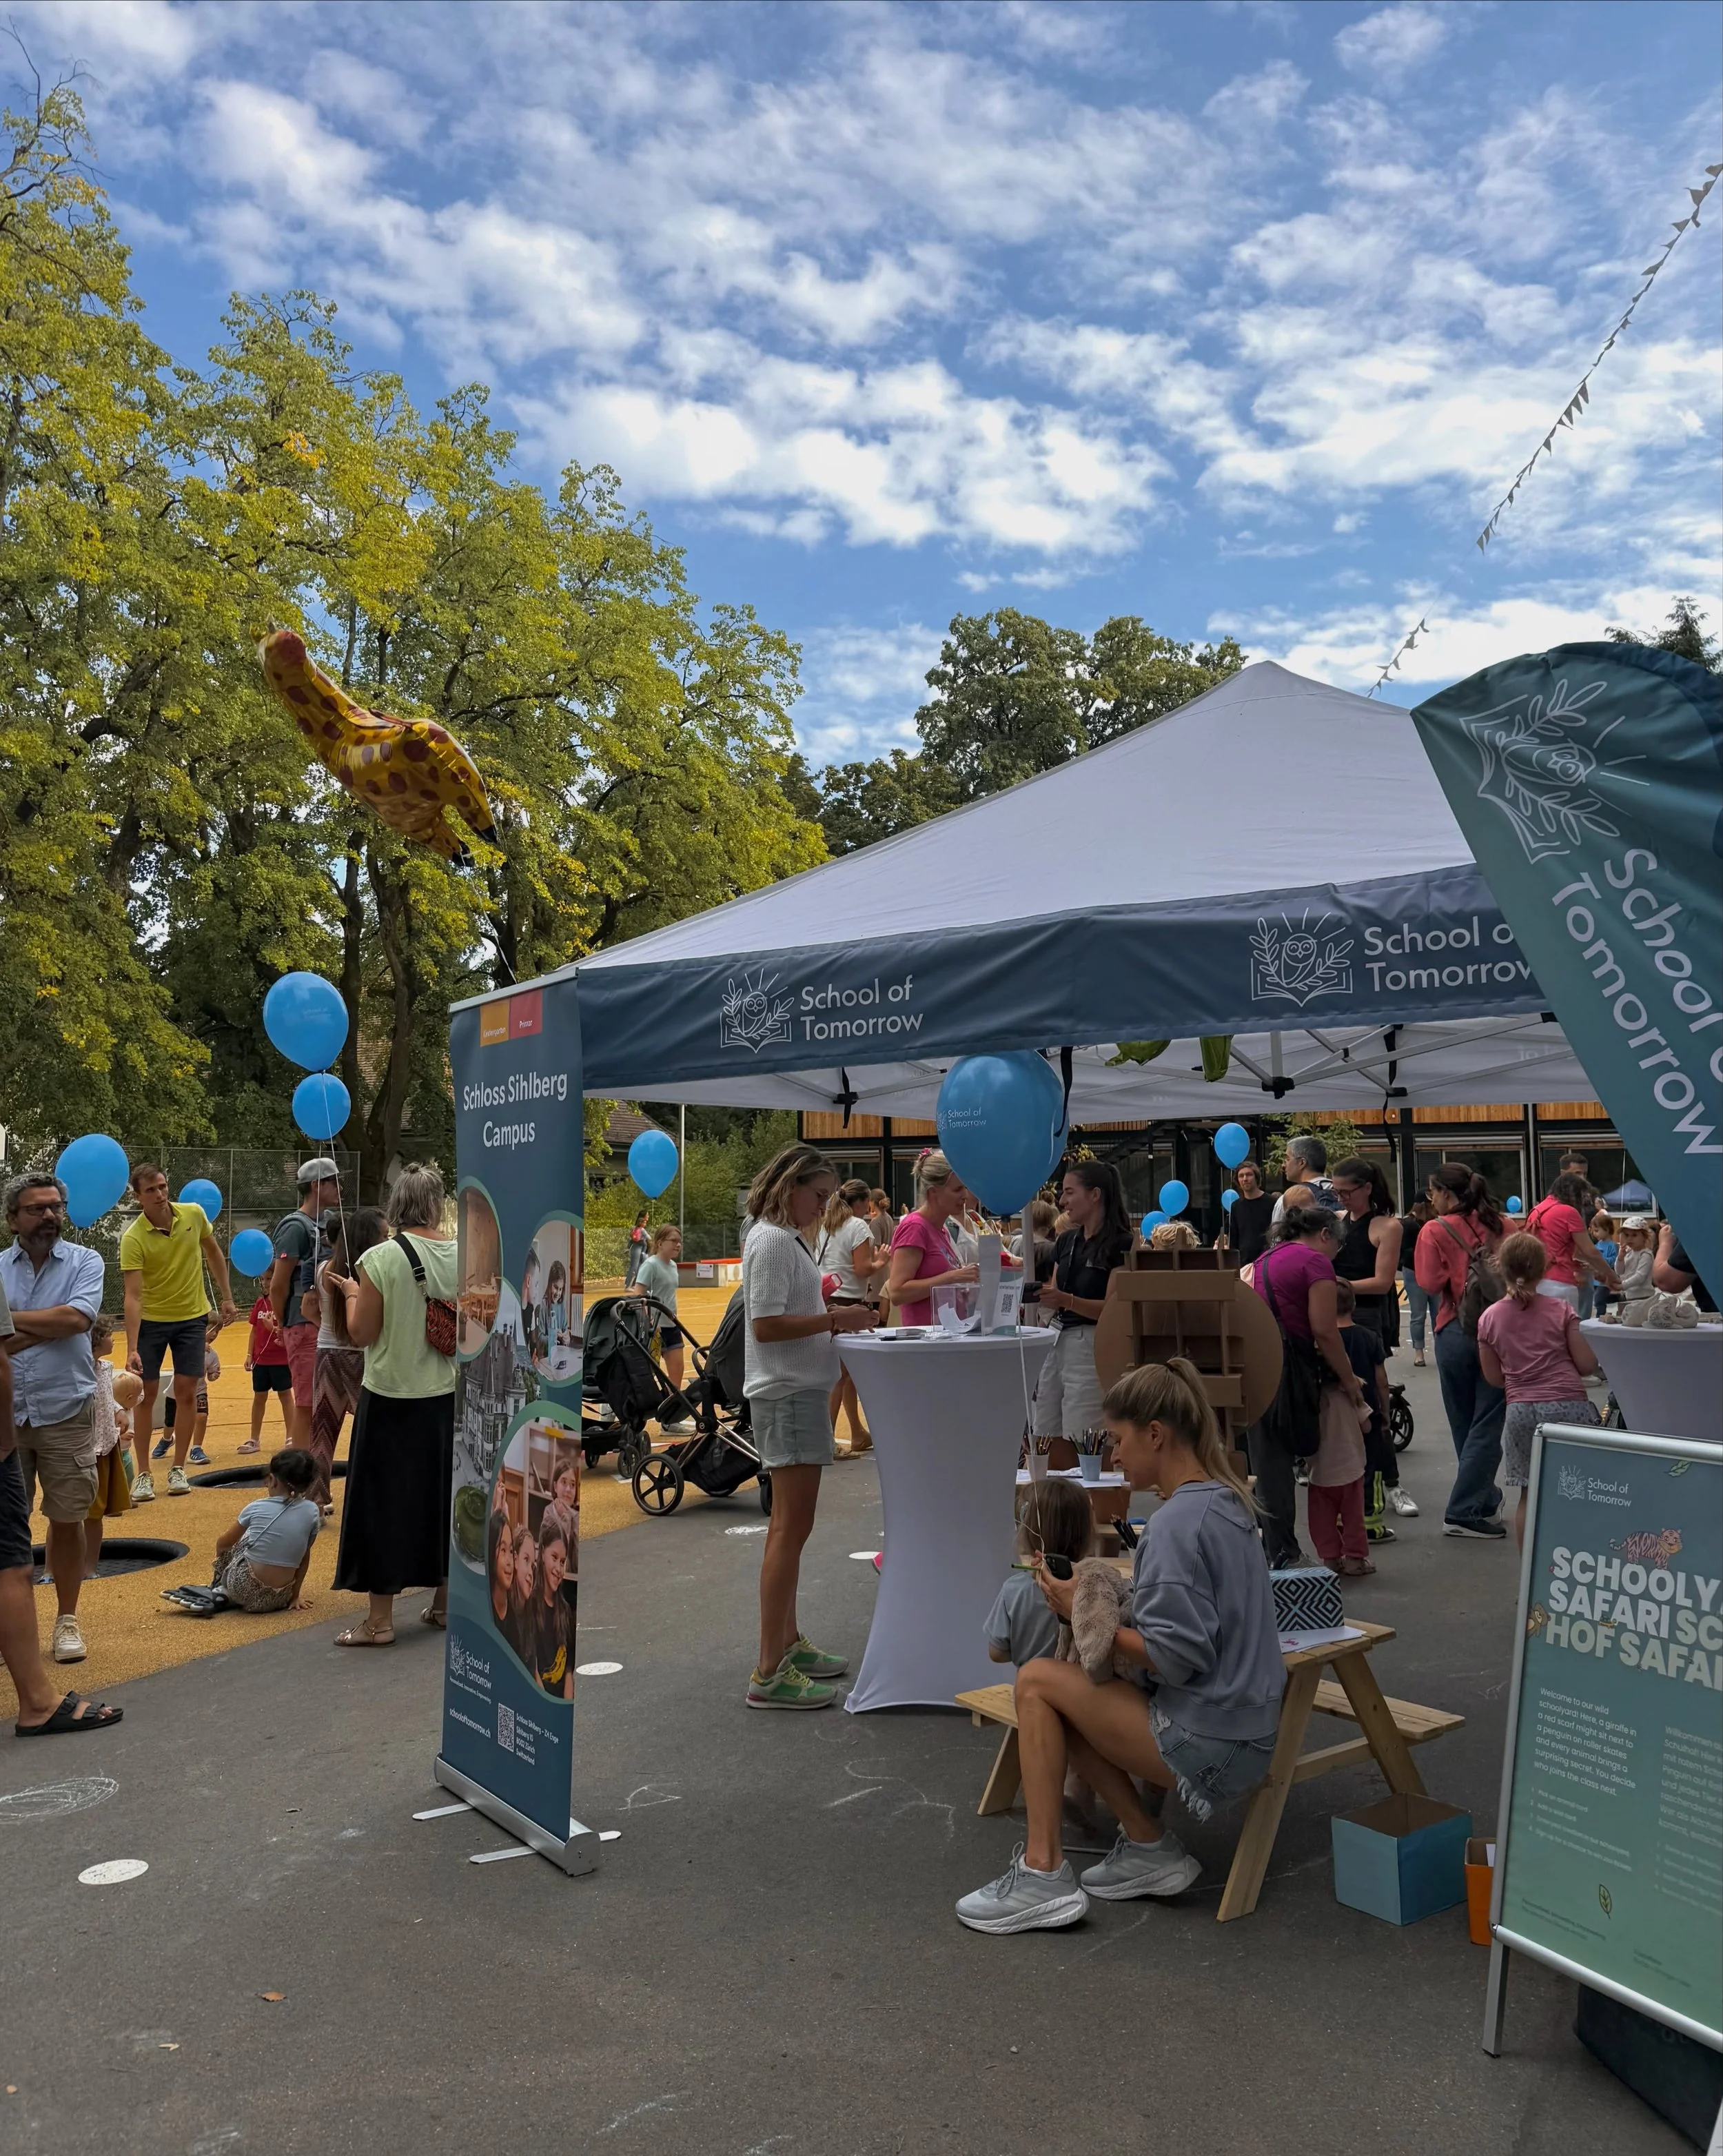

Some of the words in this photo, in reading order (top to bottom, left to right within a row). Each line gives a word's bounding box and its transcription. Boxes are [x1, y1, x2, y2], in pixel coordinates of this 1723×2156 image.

[1364, 916, 1480, 956] School
[1492, 922, 1515, 944] o
[1604, 848, 1723, 1034] School
[800, 977, 880, 1011] School
[888, 974, 913, 1001] of
[799, 1013, 924, 1041] Tomorrow
[1551, 872, 1723, 1154] Tomorrow
[463, 1081, 506, 1111] Schloss
[508, 1071, 568, 1101] Sihlberg
[948, 1108, 971, 1119] School
[973, 1106, 982, 1117] of
[948, 1119, 987, 1128] Tomorrow
[483, 1121, 536, 1150] Campus
[1587, 1477, 1617, 1492] School
[1618, 1483, 1629, 1494] of
[1587, 1490, 1631, 1507] Tomorrow
[1552, 1546, 1723, 1616] SCHOOLY
[1549, 1580, 1671, 1639] SAFARI
[1545, 1613, 1615, 1658] HOF
[466, 1651, 483, 1671] School
[484, 1662, 489, 1674] of
[466, 1665, 491, 1689] Tomorrow
[1540, 1687, 1572, 1704] Welcome
[1573, 1698, 1580, 1706] to
[1581, 1701, 1593, 1709] our
[1595, 1705, 1609, 1715] wild
[449, 1708, 491, 1738] schooloftomorrow.ch
[1539, 1700, 1578, 1718] schoolyard!
[1580, 1712, 1598, 1725] Here,
[1605, 1721, 1629, 1733] giraffe
[1630, 1727, 1636, 1737] in
[1544, 1714, 1556, 1723] red
[1557, 1718, 1575, 1729] scarf
[1576, 1725, 1597, 1737] might
[1598, 1731, 1607, 1740] sit
[1609, 1735, 1624, 1745] next
[1626, 1740, 1633, 1748] to
[1536, 1736, 1549, 1746] and
[1551, 1742, 1570, 1754] every
[1571, 1748, 1596, 1762] animal
[1598, 1756, 1621, 1771] brings
[1543, 1727, 1571, 1741] penguin
[1583, 1740, 1601, 1751] roller
[1603, 1746, 1627, 1759] skates
[1534, 1760, 1548, 1771] who
[1549, 1766, 1565, 1778] joins
[1567, 1771, 1578, 1782] the
[1580, 1778, 1598, 1789] class
[1535, 1748, 1569, 1767] surprising
[1595, 1768, 1609, 1779] You
[1610, 1774, 1636, 1789] decide
